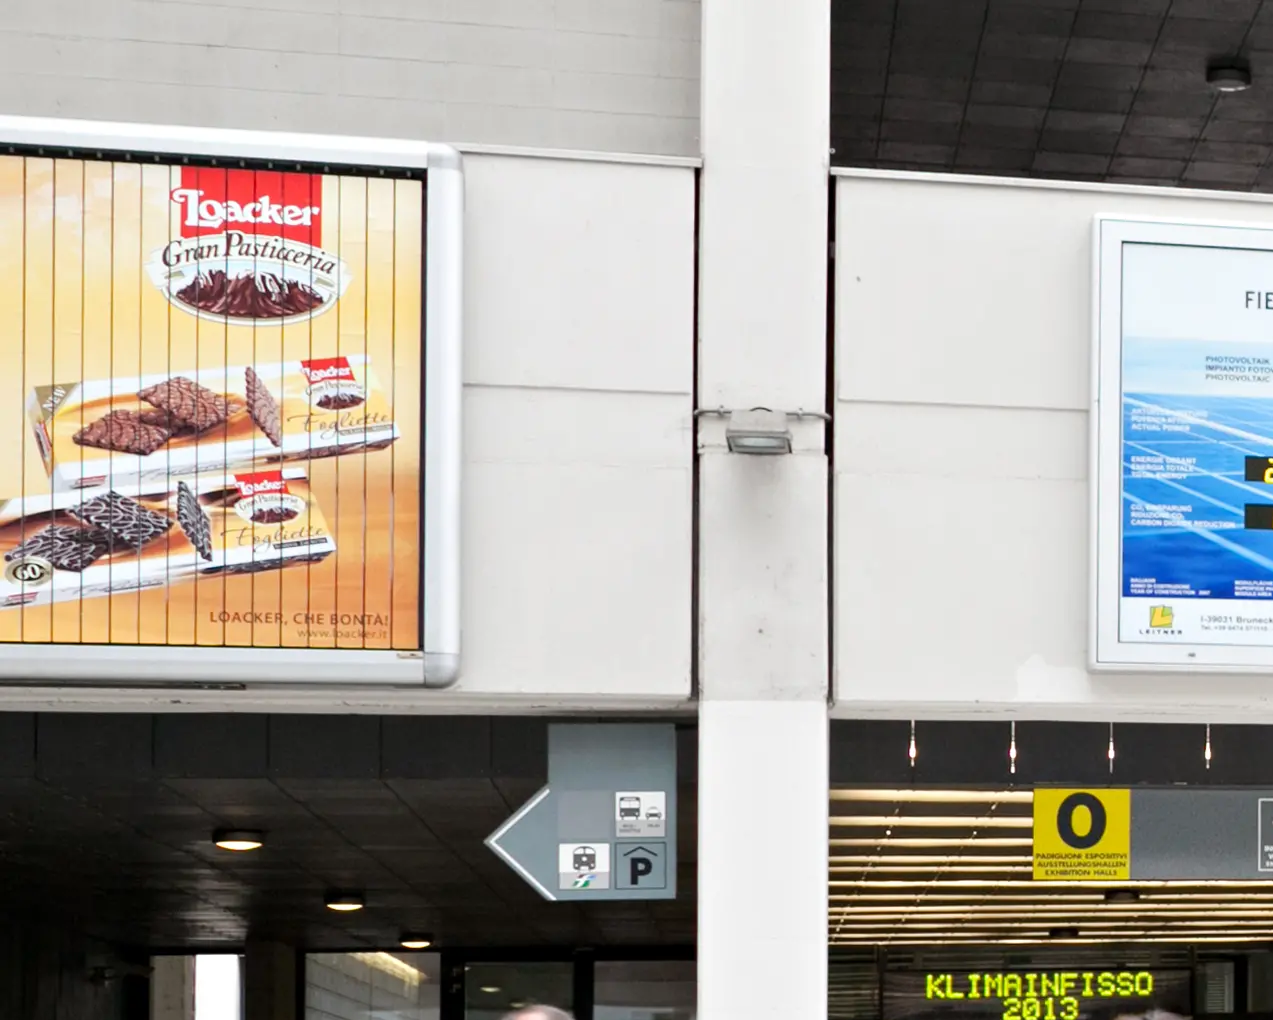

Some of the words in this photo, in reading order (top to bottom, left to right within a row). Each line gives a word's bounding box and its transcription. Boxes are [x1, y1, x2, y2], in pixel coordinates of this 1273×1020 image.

[171, 188, 321, 228] Loacker
[162, 239, 219, 268] Gran
[222, 231, 337, 275] Pasticceria
[1205, 355, 1271, 366] PHOTOVOLTAIK
[1205, 364, 1246, 373] IMPIANTO
[1205, 373, 1271, 383] PHOTOVOLTAIC
[42, 385, 66, 410] NEW
[210, 611, 288, 626] LOACKER,
[293, 612, 325, 625] CHE
[1035, 852, 1083, 860] PADIGLIONI
[1085, 852, 1128, 860] ESPOSITIVI
[630, 857, 653, 886] P
[1037, 861, 1126, 869] AUSSTELLUNGSHALLEN
[1045, 869, 1091, 877] EXHIBITION
[925, 971, 1154, 999] KLIMAINFISSO
